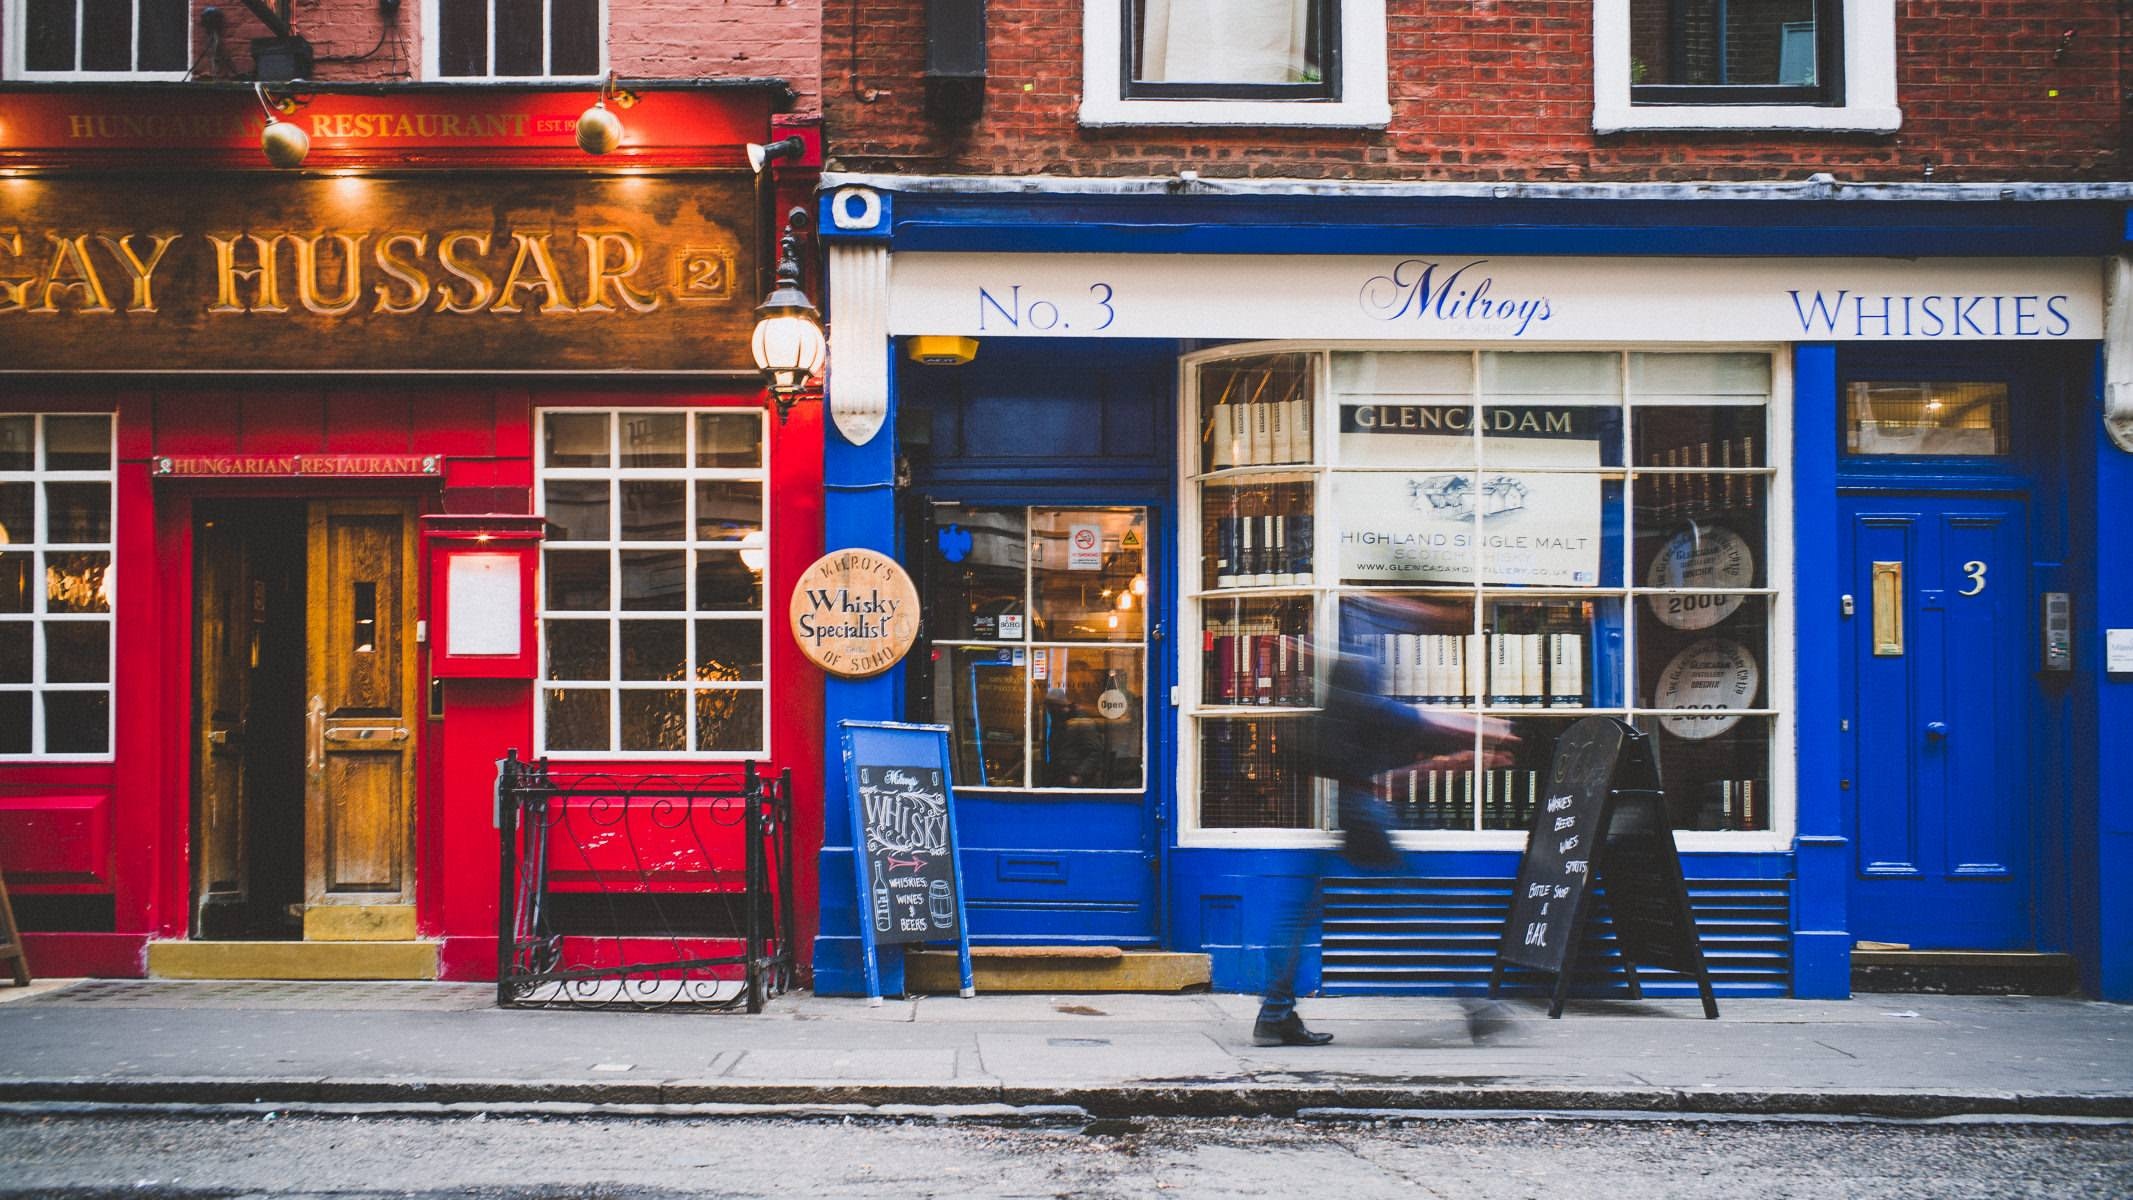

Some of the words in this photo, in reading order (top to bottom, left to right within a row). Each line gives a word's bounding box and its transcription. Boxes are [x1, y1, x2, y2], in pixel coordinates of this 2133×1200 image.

[311, 113, 529, 138] RESTAURANT
[537, 119, 562, 132] EST.
[564, 119, 577, 132] 19
[205, 228, 662, 314] HUSSAR
[688, 259, 721, 291] 2
[979, 284, 1070, 330] No.
[1088, 282, 1115, 330] 3
[1785, 289, 2070, 337] WHISKIES
[1353, 405, 1572, 433] GLENCADAM
[174, 458, 292, 473] HUNGARIAN
[301, 458, 420, 473] RESTAURANT
[1340, 531, 1446, 547] HIGHLAND
[1535, 537, 1588, 551] MALT
[1356, 562, 1568, 577] WWW.GLENCADAMDITILLERY.CO.UK
[1957, 560, 1988, 597] 3
[805, 588, 899, 618] Whisky
[1668, 592, 1726, 614] 2000
[799, 613, 893, 647] Specialist
[823, 650, 843, 666] OF
[850, 645, 895, 671] SOHO
[1101, 700, 1124, 711] Open
[864, 794, 948, 850] WHISKY
[895, 893, 925, 905] WINES
[1528, 882, 1551, 899] BOTTLE
[900, 918, 928, 932] BEERS
[1525, 922, 1548, 947] BAR
